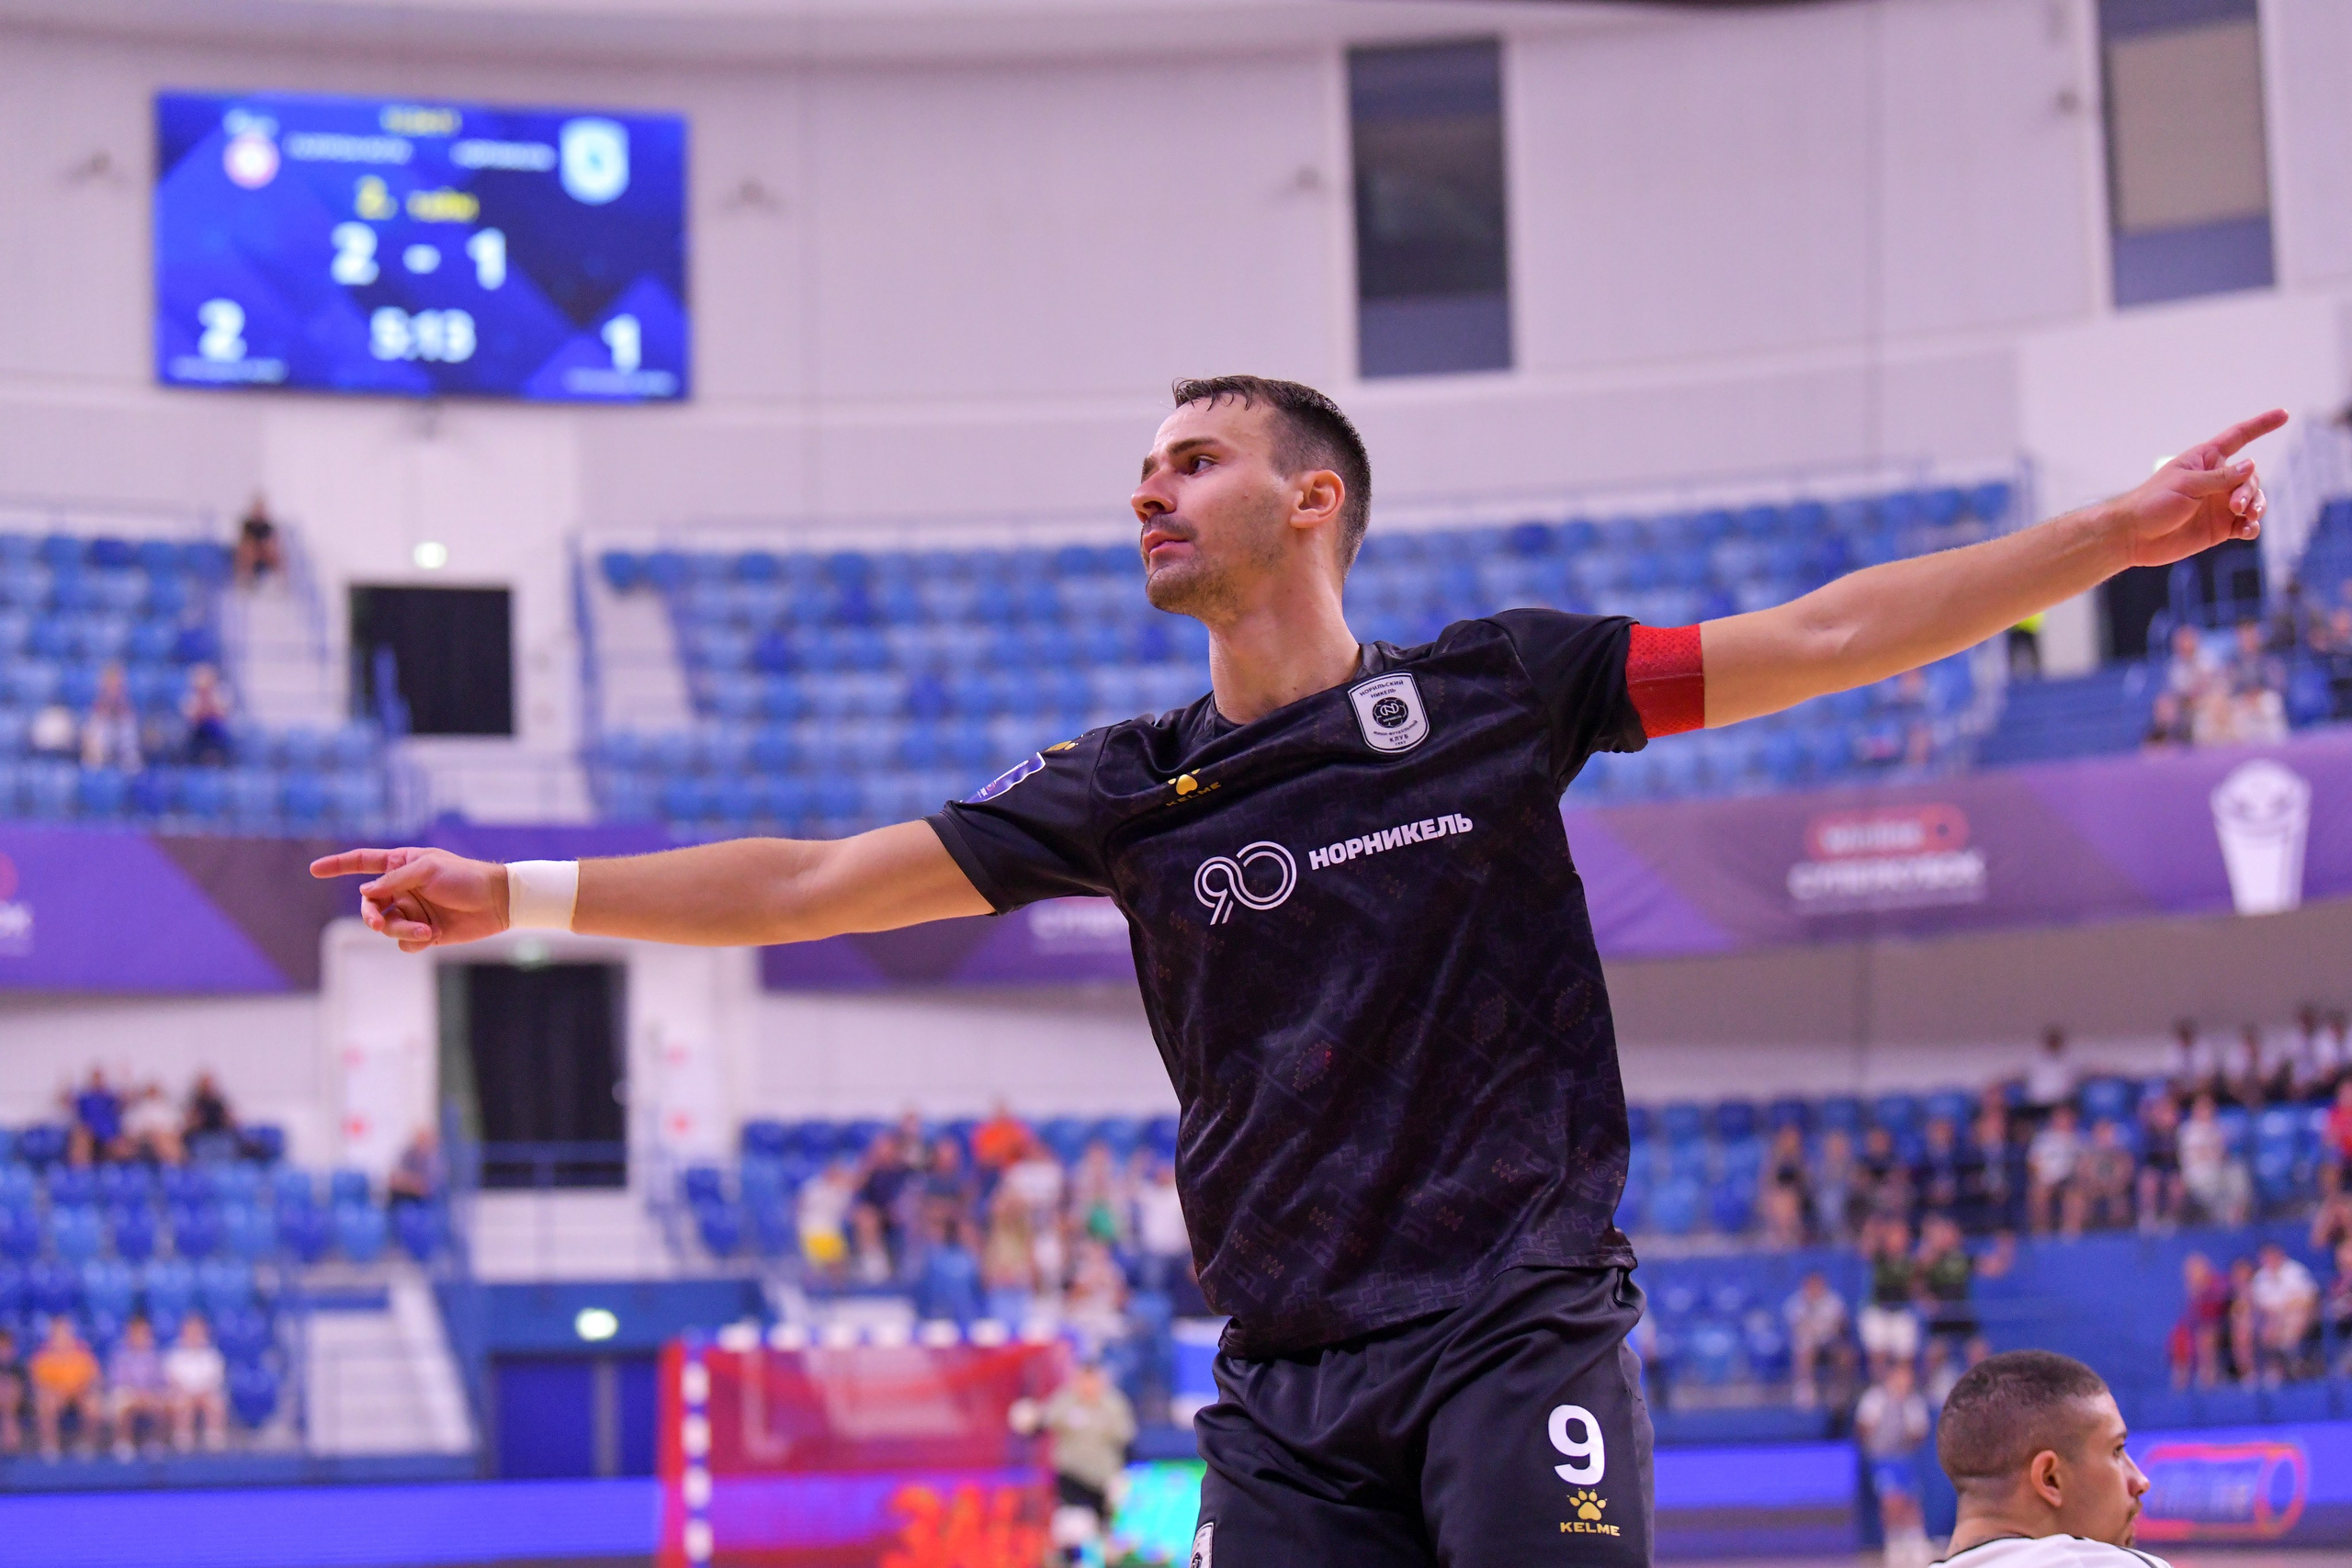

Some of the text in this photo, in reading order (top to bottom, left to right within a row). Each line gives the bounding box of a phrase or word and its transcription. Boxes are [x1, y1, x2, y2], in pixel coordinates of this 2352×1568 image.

[330, 221, 379, 287] 2
[466, 227, 507, 290] 1
[197, 298, 247, 363] 2
[600, 313, 642, 372] 1
[1360, 680, 1404, 696] НОРИЛЬСКИЙ
[1371, 688, 1396, 698] НИКЕЛЬ
[1389, 734, 1409, 743] КЛУБ
[1166, 782, 1221, 807] KELME
[1308, 813, 1474, 871] НОРНИКЕЛЬ
[1193, 840, 1297, 926] 90
[1548, 1404, 1605, 1485] 9
[1560, 1521, 1621, 1537] KELME
